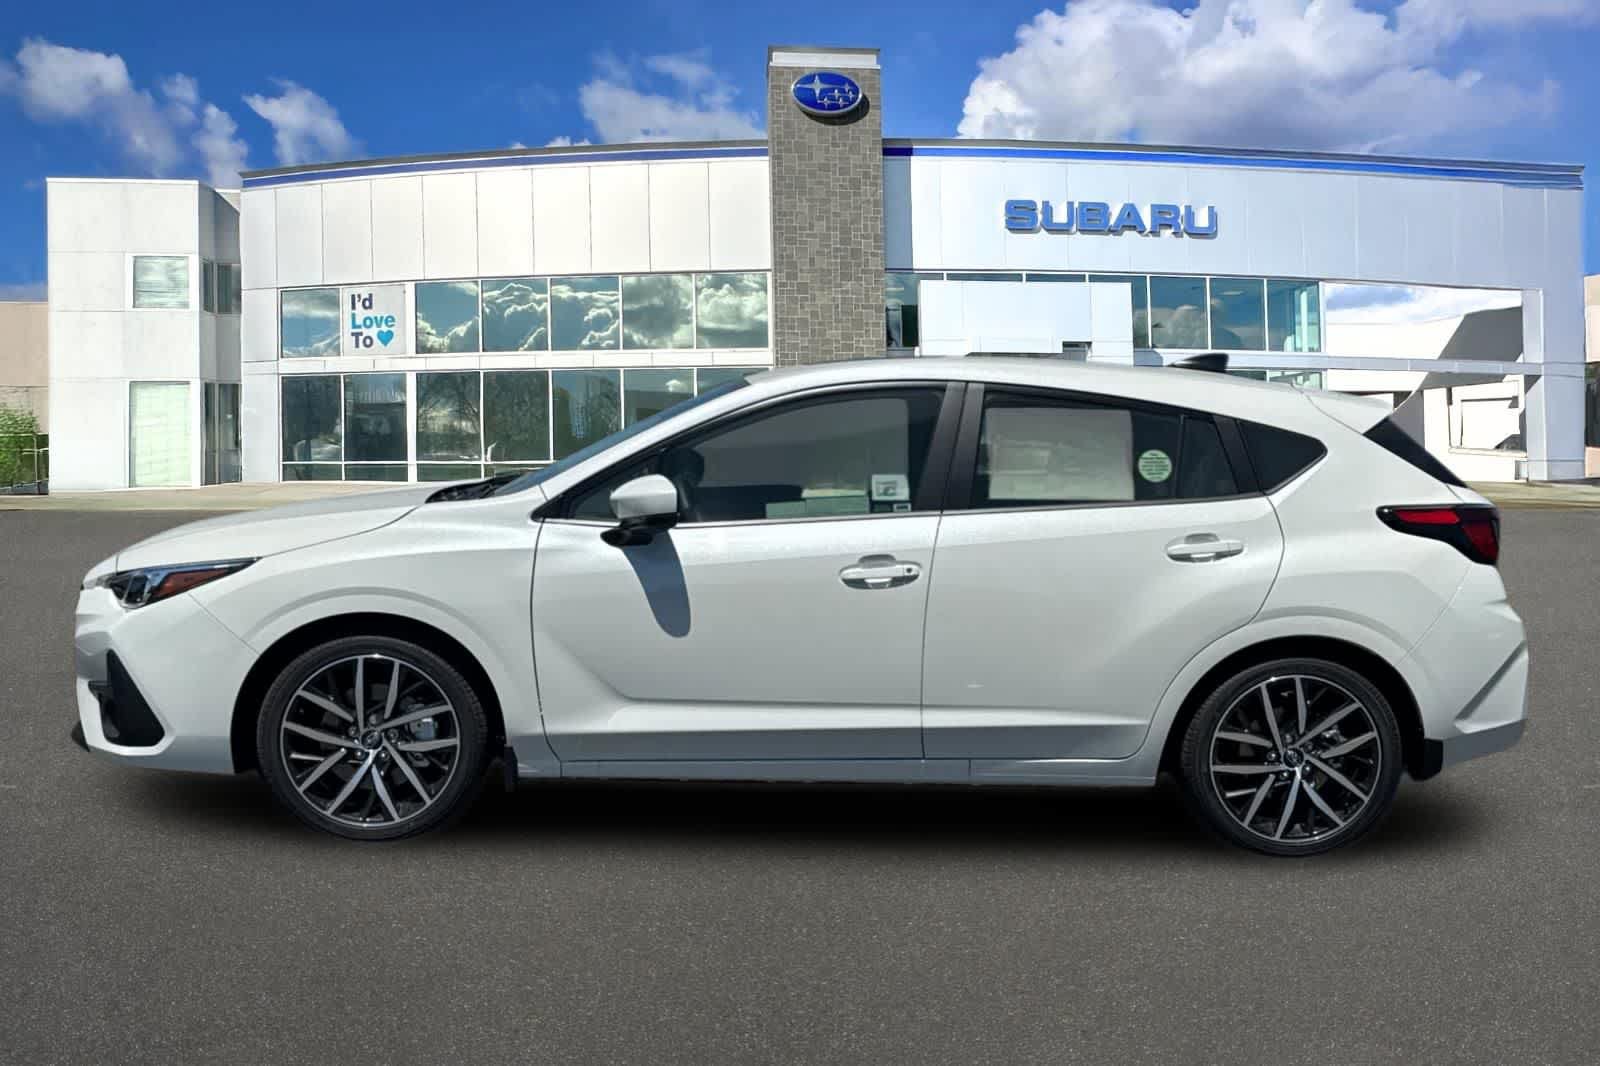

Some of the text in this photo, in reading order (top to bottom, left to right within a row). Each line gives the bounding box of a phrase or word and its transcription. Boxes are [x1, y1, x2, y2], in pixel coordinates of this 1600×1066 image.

[1005, 199, 1218, 238] SUBARU
[350, 292, 374, 311] I'd
[350, 311, 396, 330] Love
[350, 331, 374, 349] To
